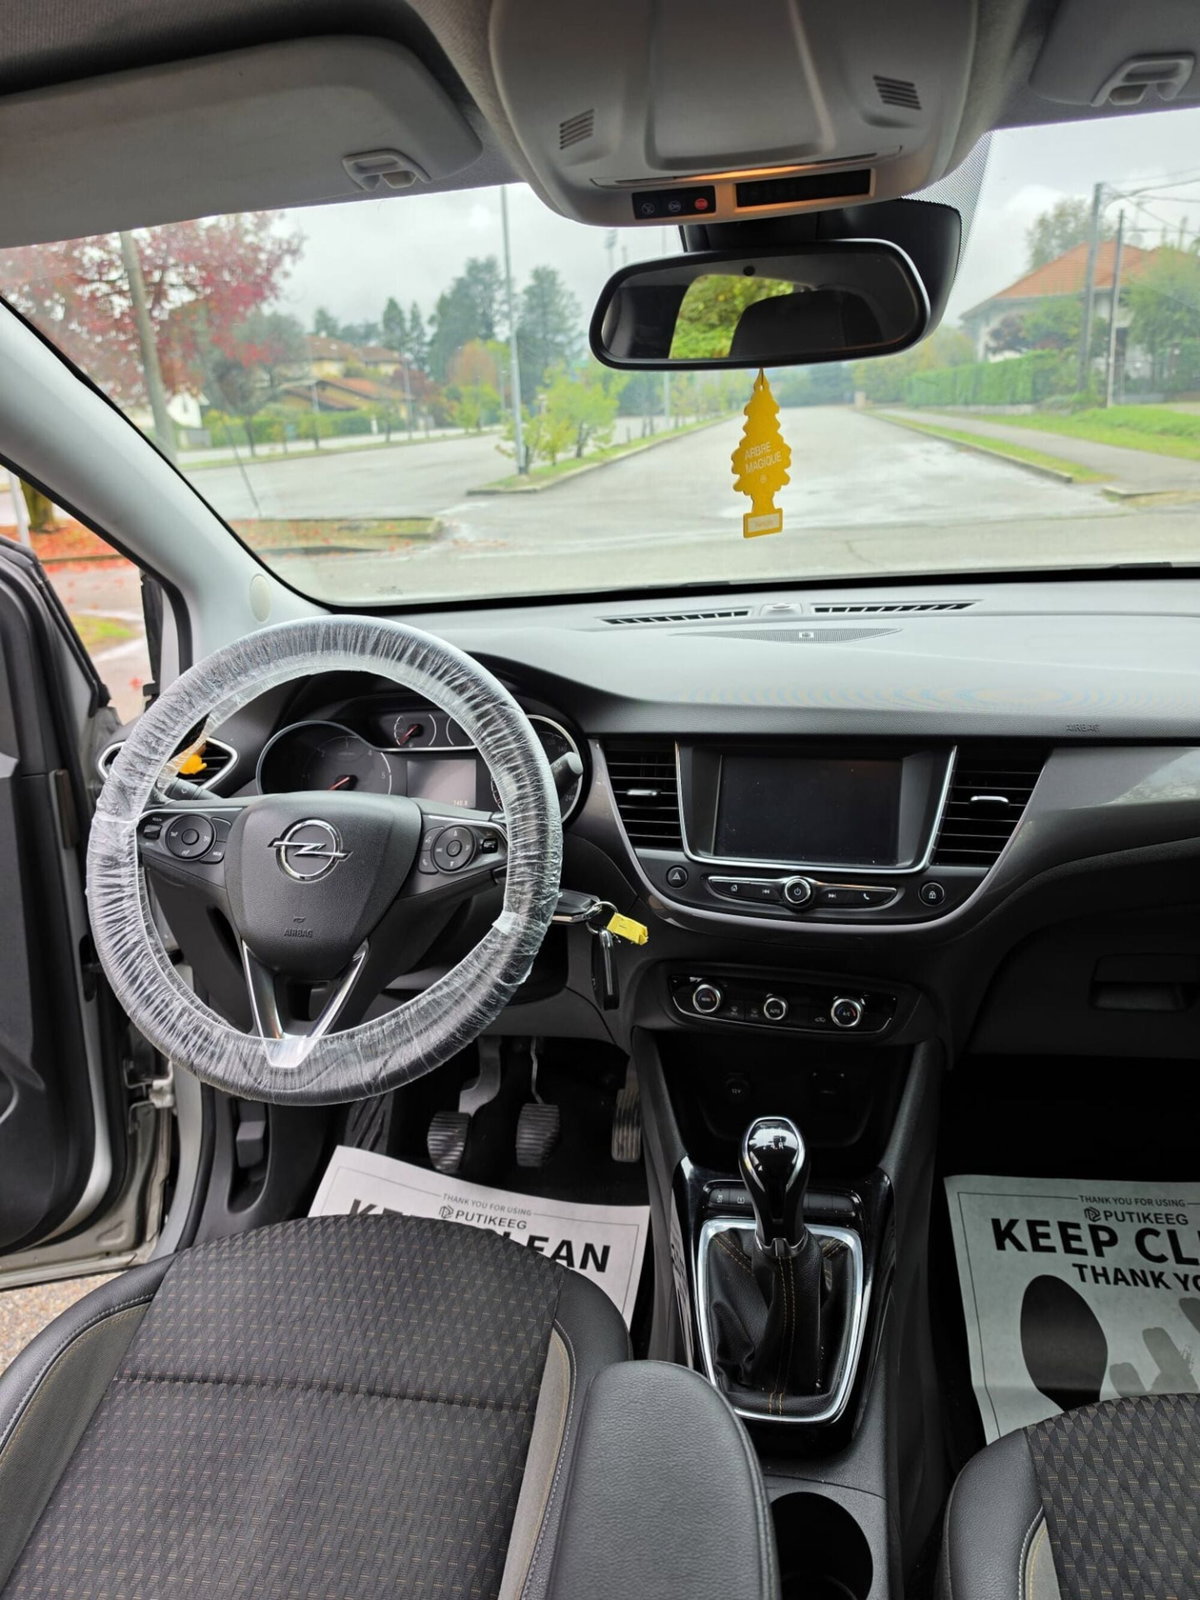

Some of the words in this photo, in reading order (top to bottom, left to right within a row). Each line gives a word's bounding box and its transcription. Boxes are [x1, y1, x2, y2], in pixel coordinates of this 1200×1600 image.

[744, 441, 771, 460] ARBRE
[745, 451, 782, 473] MAGIQUE
[1065, 723, 1100, 733] AIRBAG
[283, 928, 314, 939] AIRBAG
[442, 1193, 469, 1206] THANK
[471, 1199, 488, 1209] YOU
[489, 1203, 505, 1212] FOR
[506, 1206, 533, 1217] USING
[1078, 1194, 1112, 1205] THANK
[1112, 1196, 1132, 1206] YOU
[1134, 1198, 1154, 1207] FOR
[1155, 1199, 1186, 1208] USING
[455, 1209, 528, 1231] PUTIKEEG
[1102, 1209, 1190, 1226] PUTIKEEG
[991, 1217, 1119, 1258] KEEP
[1134, 1227, 1200, 1266] CL
[1071, 1262, 1173, 1291] THANK
